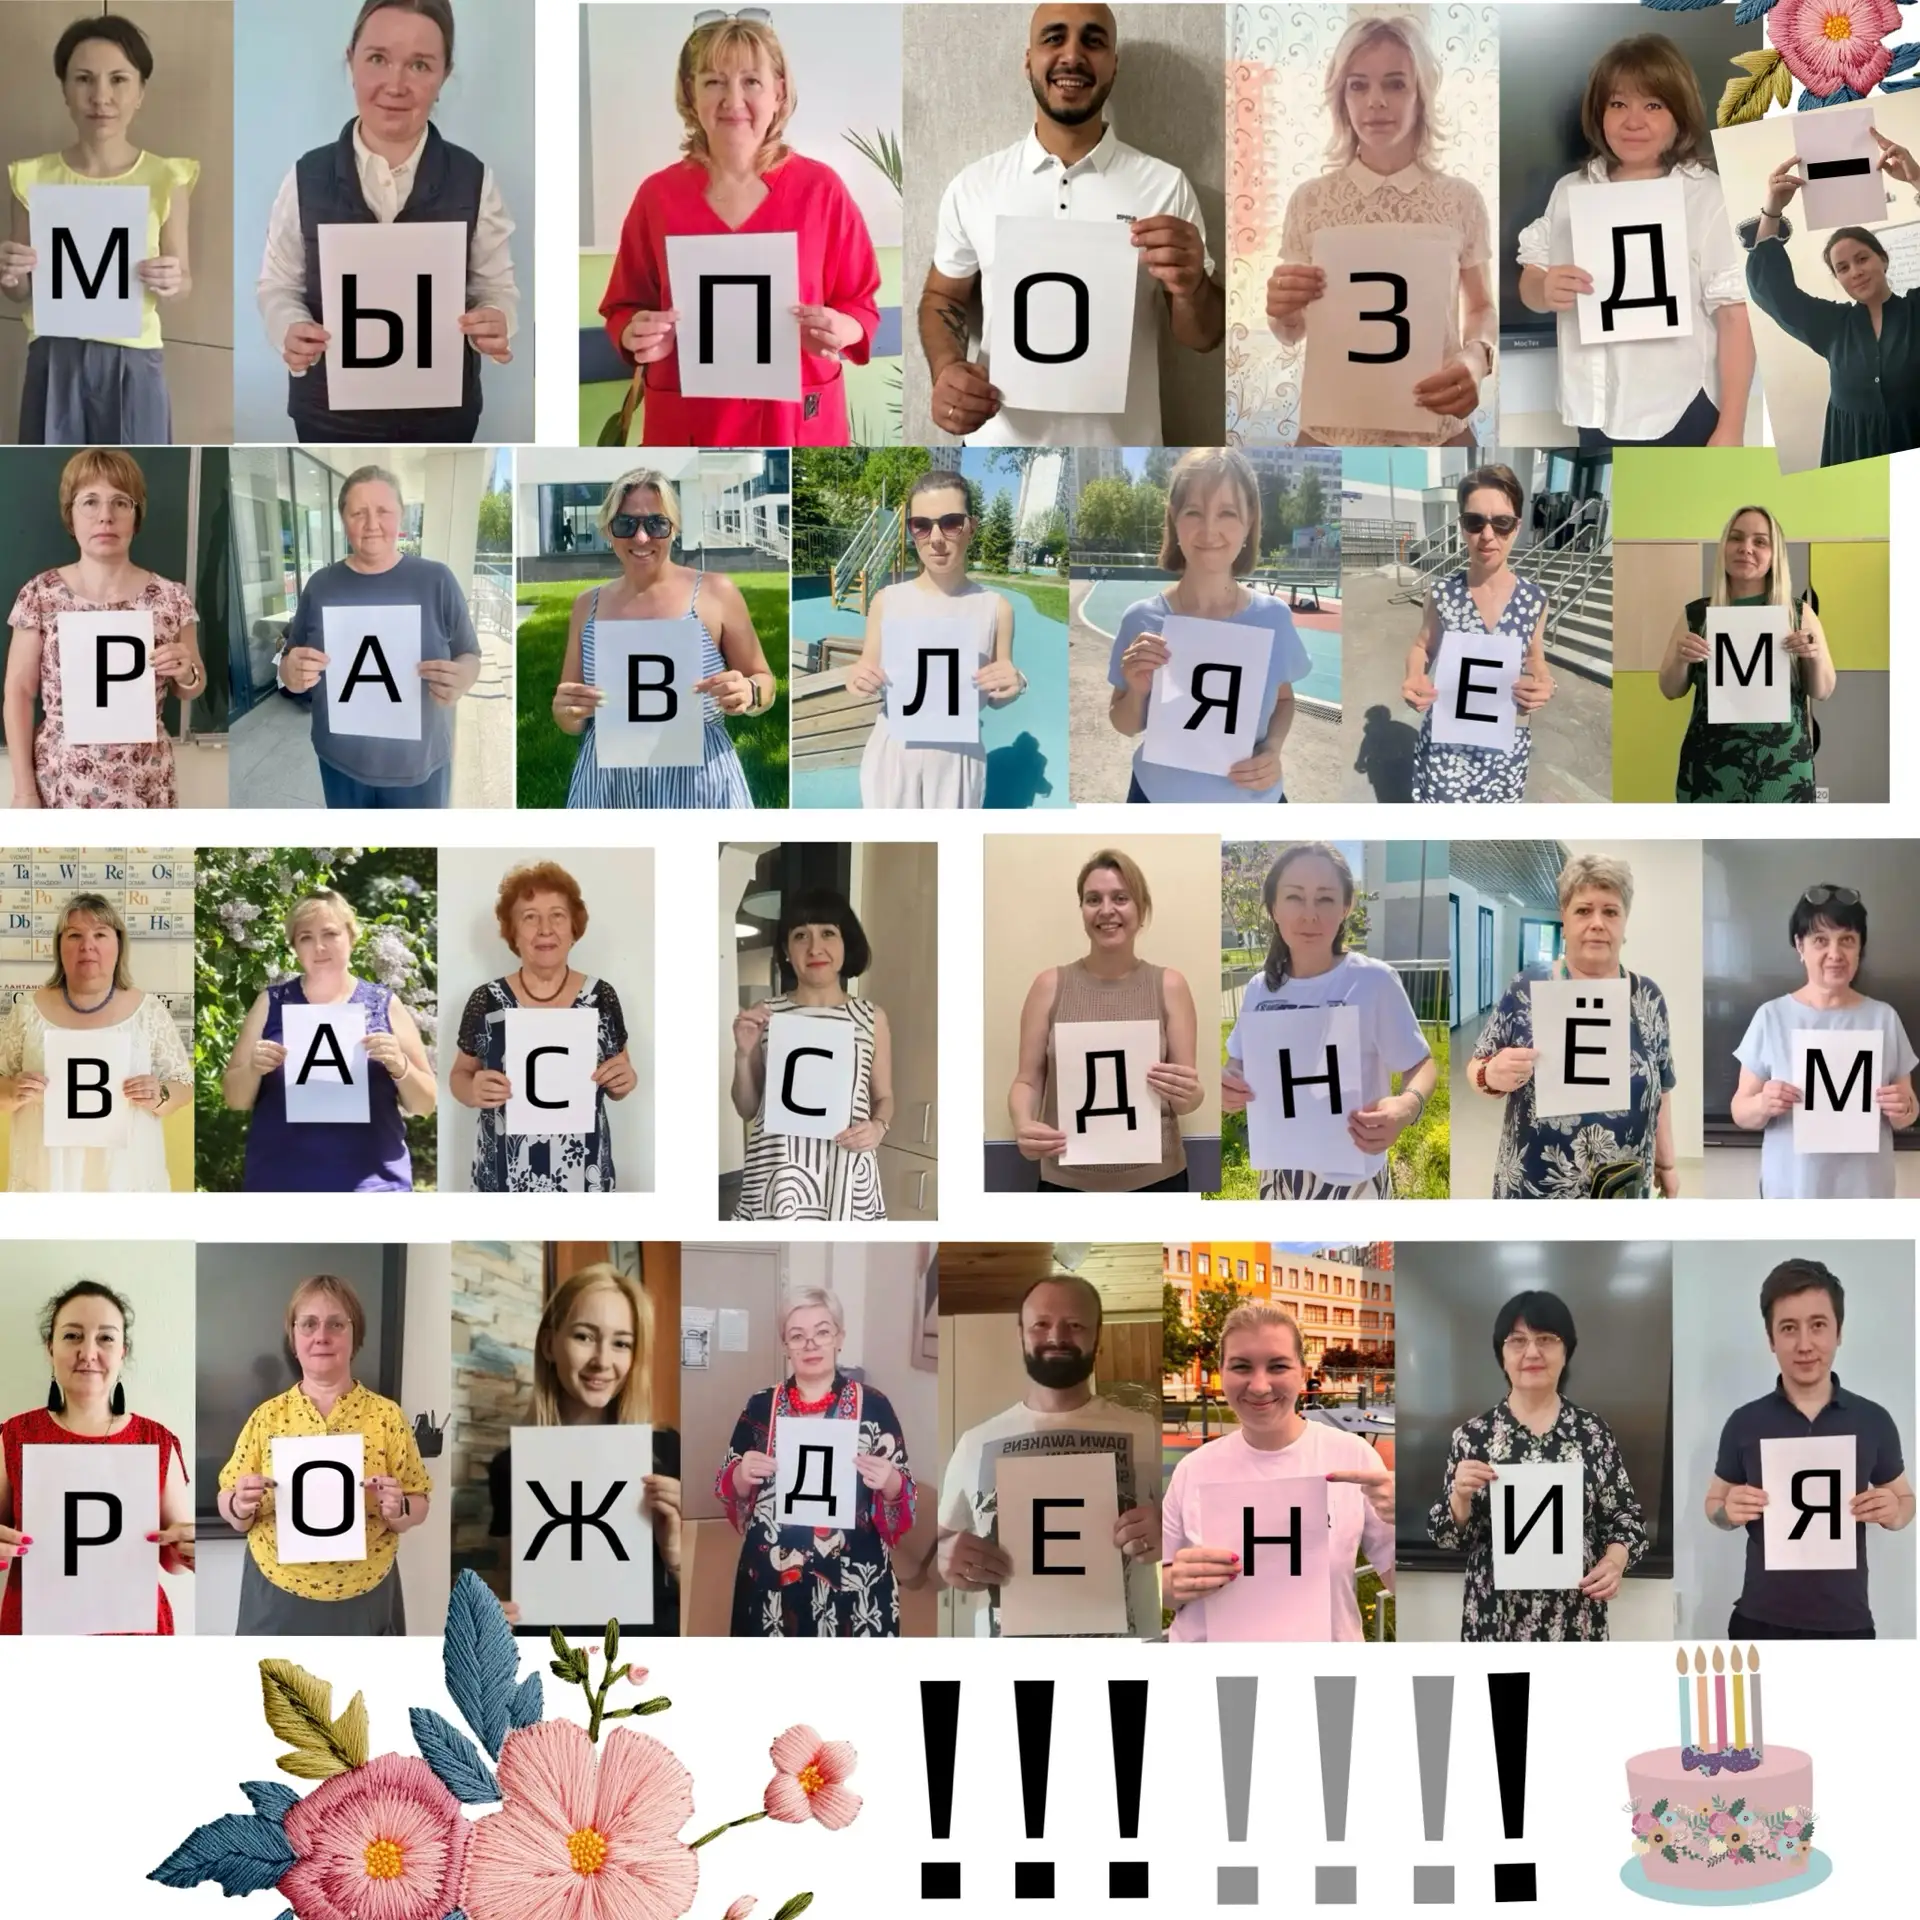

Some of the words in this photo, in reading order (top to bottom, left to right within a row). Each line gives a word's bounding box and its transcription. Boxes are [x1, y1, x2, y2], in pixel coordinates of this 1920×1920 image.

[13, 864, 30, 879] Ta
[60, 864, 77, 879] W
[105, 864, 124, 880] Re
[152, 863, 172, 880] Os
[36, 889, 52, 905] Po
[129, 890, 149, 905] Rn
[10, 914, 30, 929] Db
[150, 915, 171, 930] Hs
